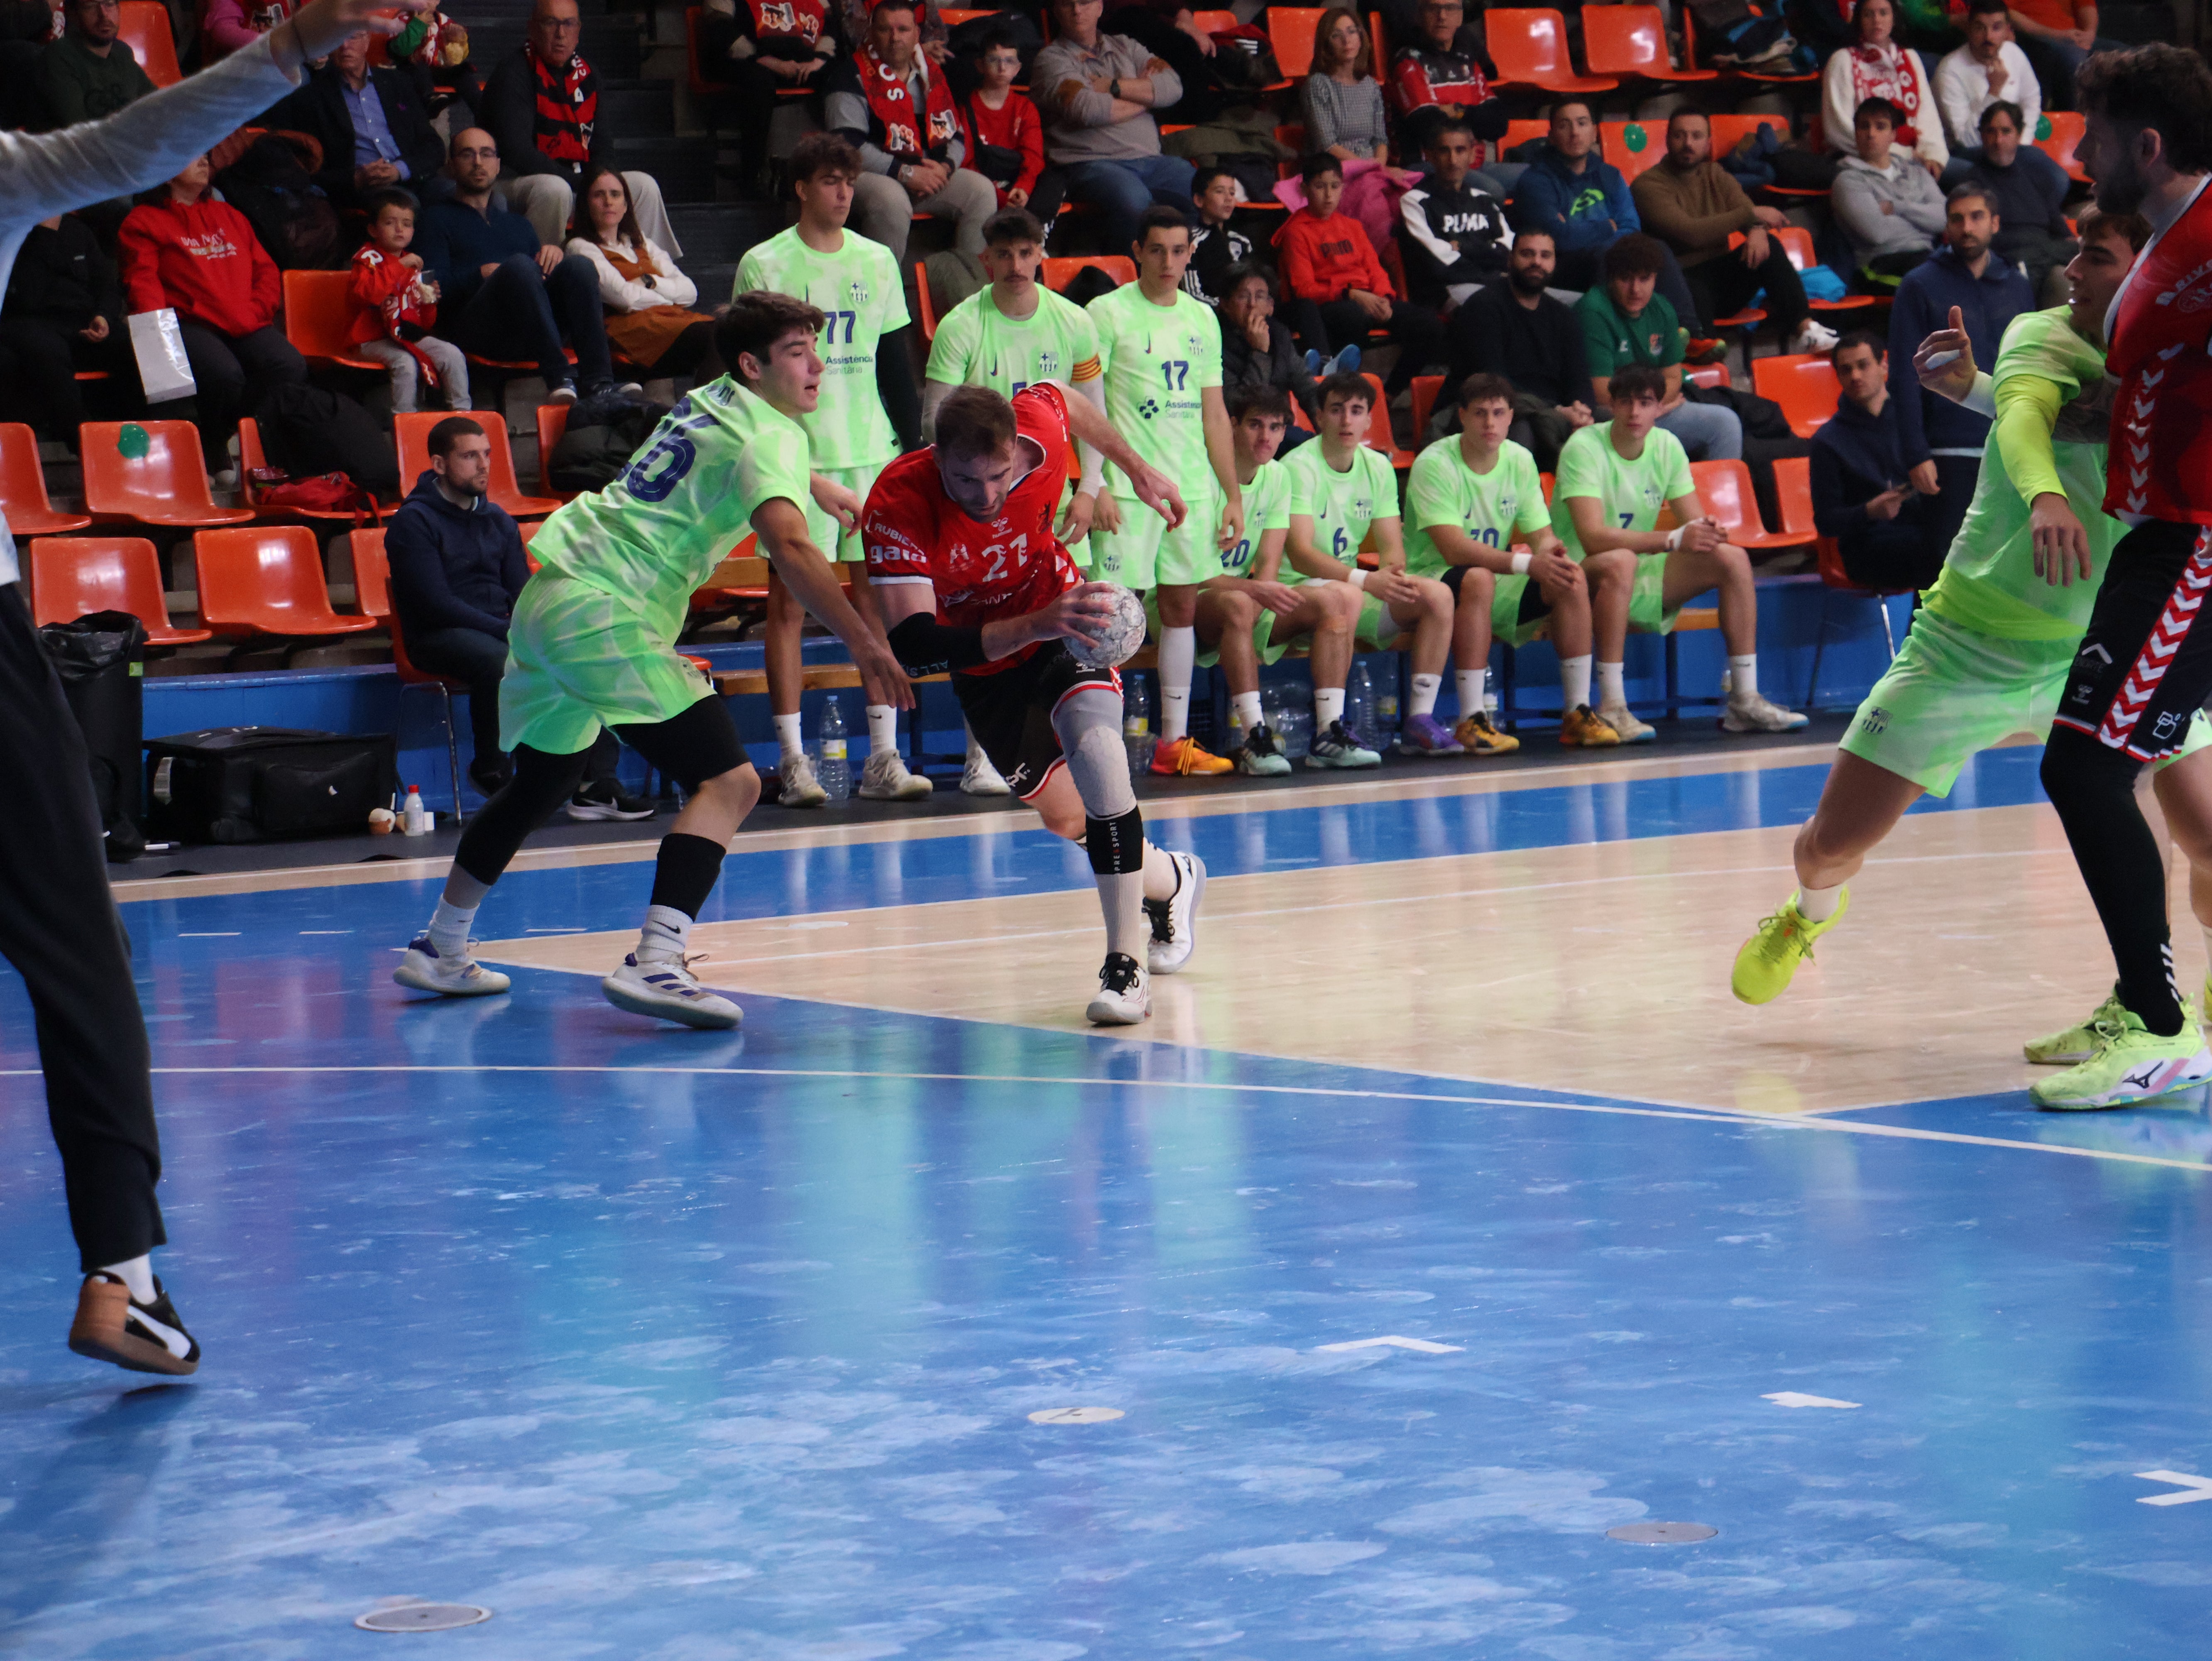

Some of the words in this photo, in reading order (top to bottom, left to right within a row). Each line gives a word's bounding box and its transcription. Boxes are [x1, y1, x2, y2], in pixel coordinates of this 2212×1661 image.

[1442, 212, 1490, 233] PUMA
[824, 311, 856, 344] 77
[1161, 360, 1189, 390] 17
[1333, 527, 1348, 557] 6
[981, 532, 1028, 583] 21
